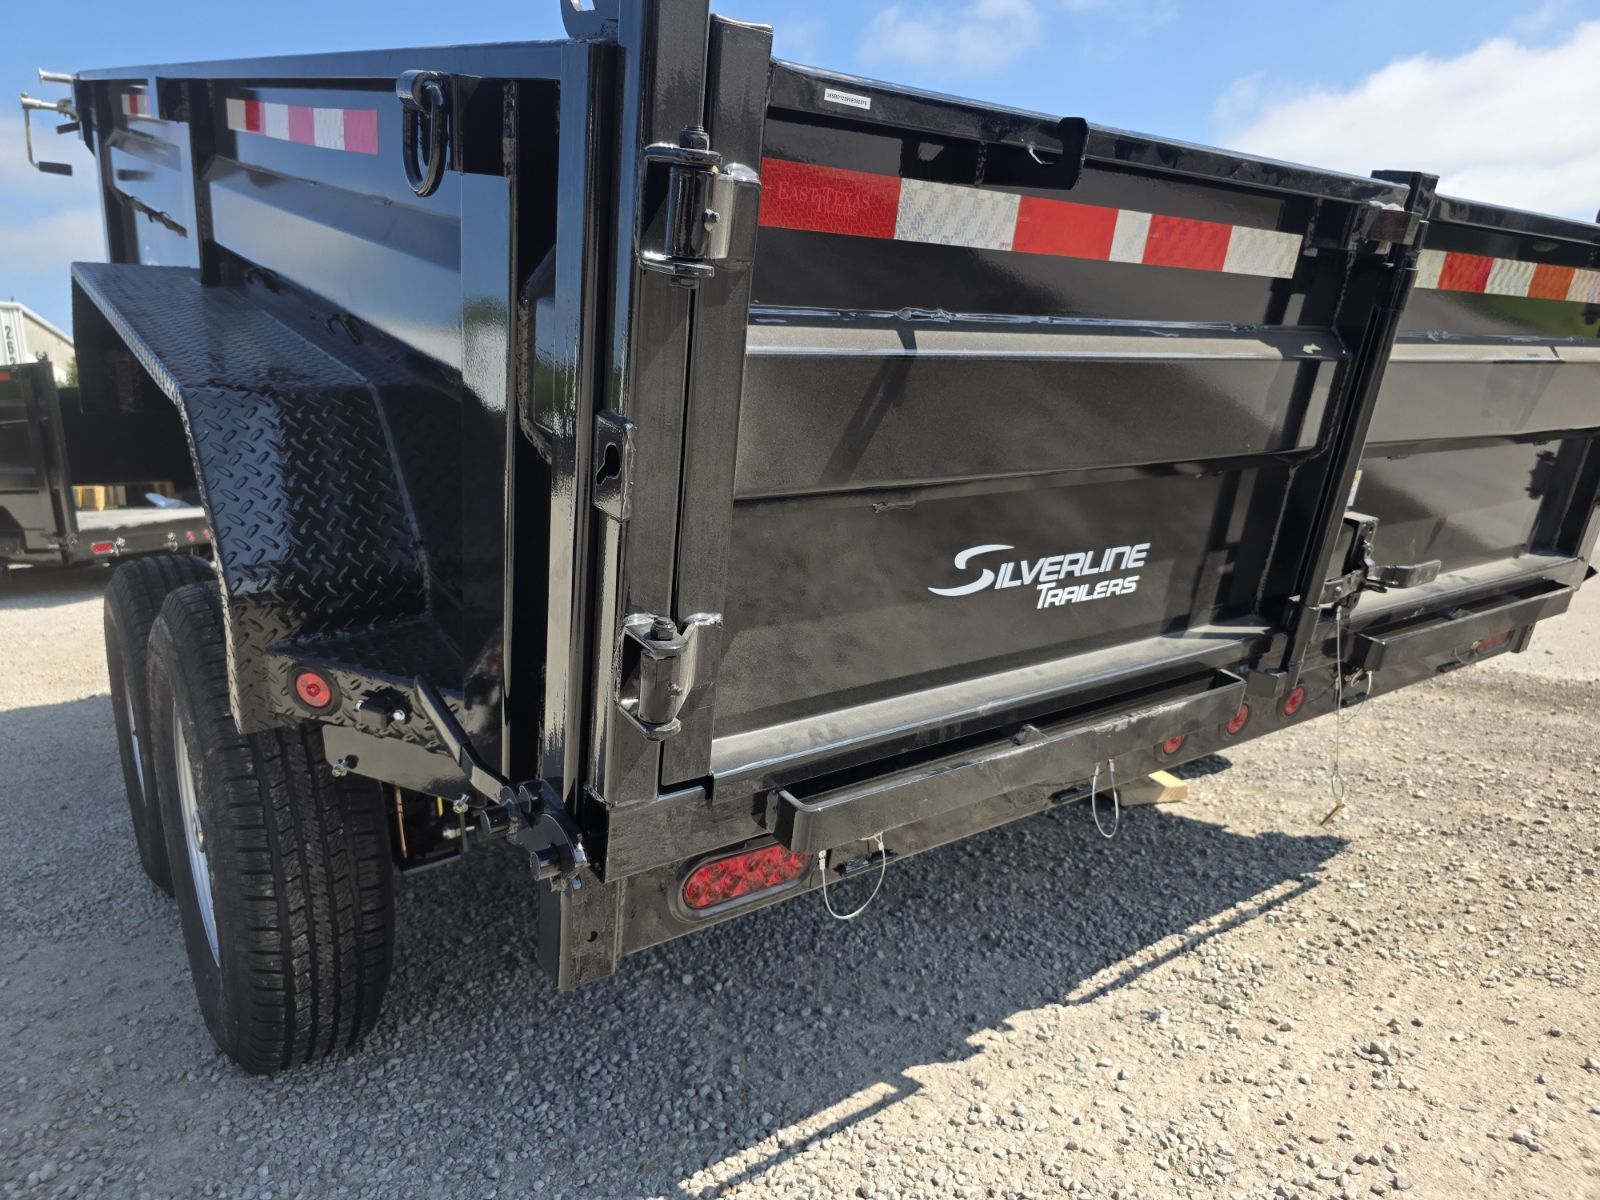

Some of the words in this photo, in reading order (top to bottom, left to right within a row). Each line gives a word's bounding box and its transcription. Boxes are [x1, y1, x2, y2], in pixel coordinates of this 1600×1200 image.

[777, 180, 819, 203] EAST
[822, 186, 871, 210] TEXAS
[928, 542, 1151, 597] SILVERLINE
[1036, 575, 1140, 610] TRAILERS
